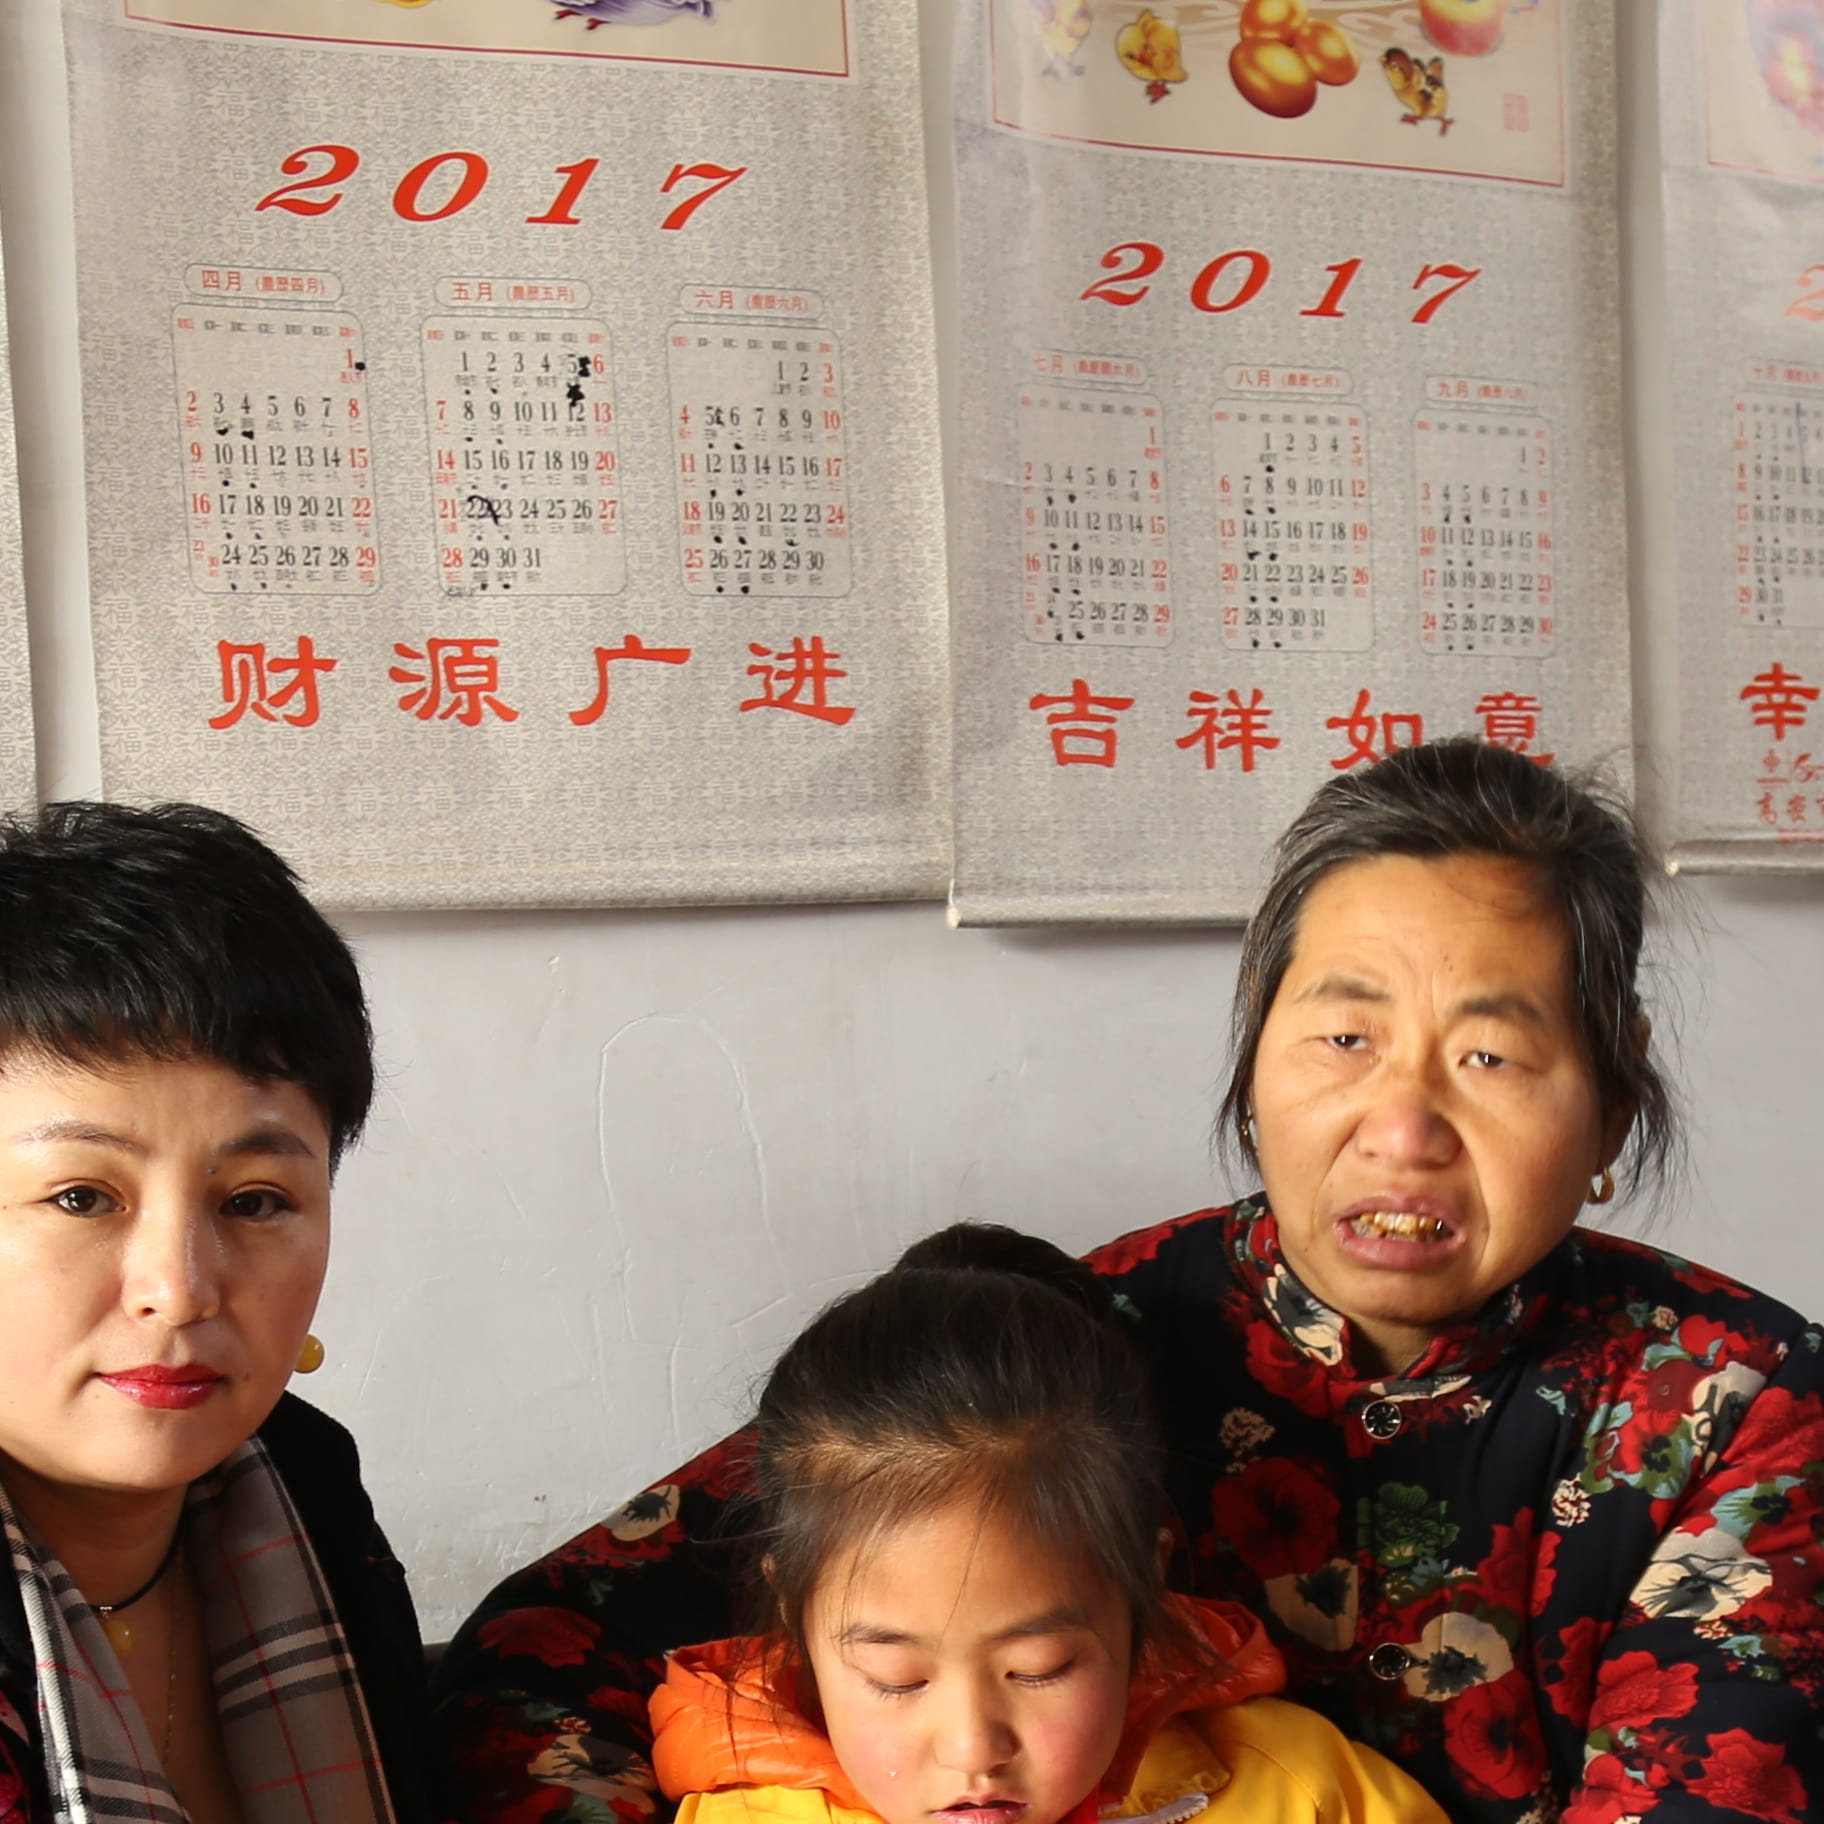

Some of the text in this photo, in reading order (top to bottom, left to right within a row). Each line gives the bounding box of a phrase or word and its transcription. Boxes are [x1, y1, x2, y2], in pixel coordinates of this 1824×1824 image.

[256, 144, 746, 230] 2017
[201, 270, 243, 292] 四月
[452, 282, 492, 301] 五月
[1082, 242, 1481, 324] 2017
[695, 290, 734, 309] 六月
[1237, 369, 1271, 388] 八月
[214, 443, 341, 468] 10 11 12 13 14
[464, 449, 616, 471] 15 16 17 18 19 20
[706, 453, 820, 477] 12 13 14 15 16
[1243, 519, 1368, 541] 14 15 16 17 18 19
[208, 634, 856, 730] 财源广进
